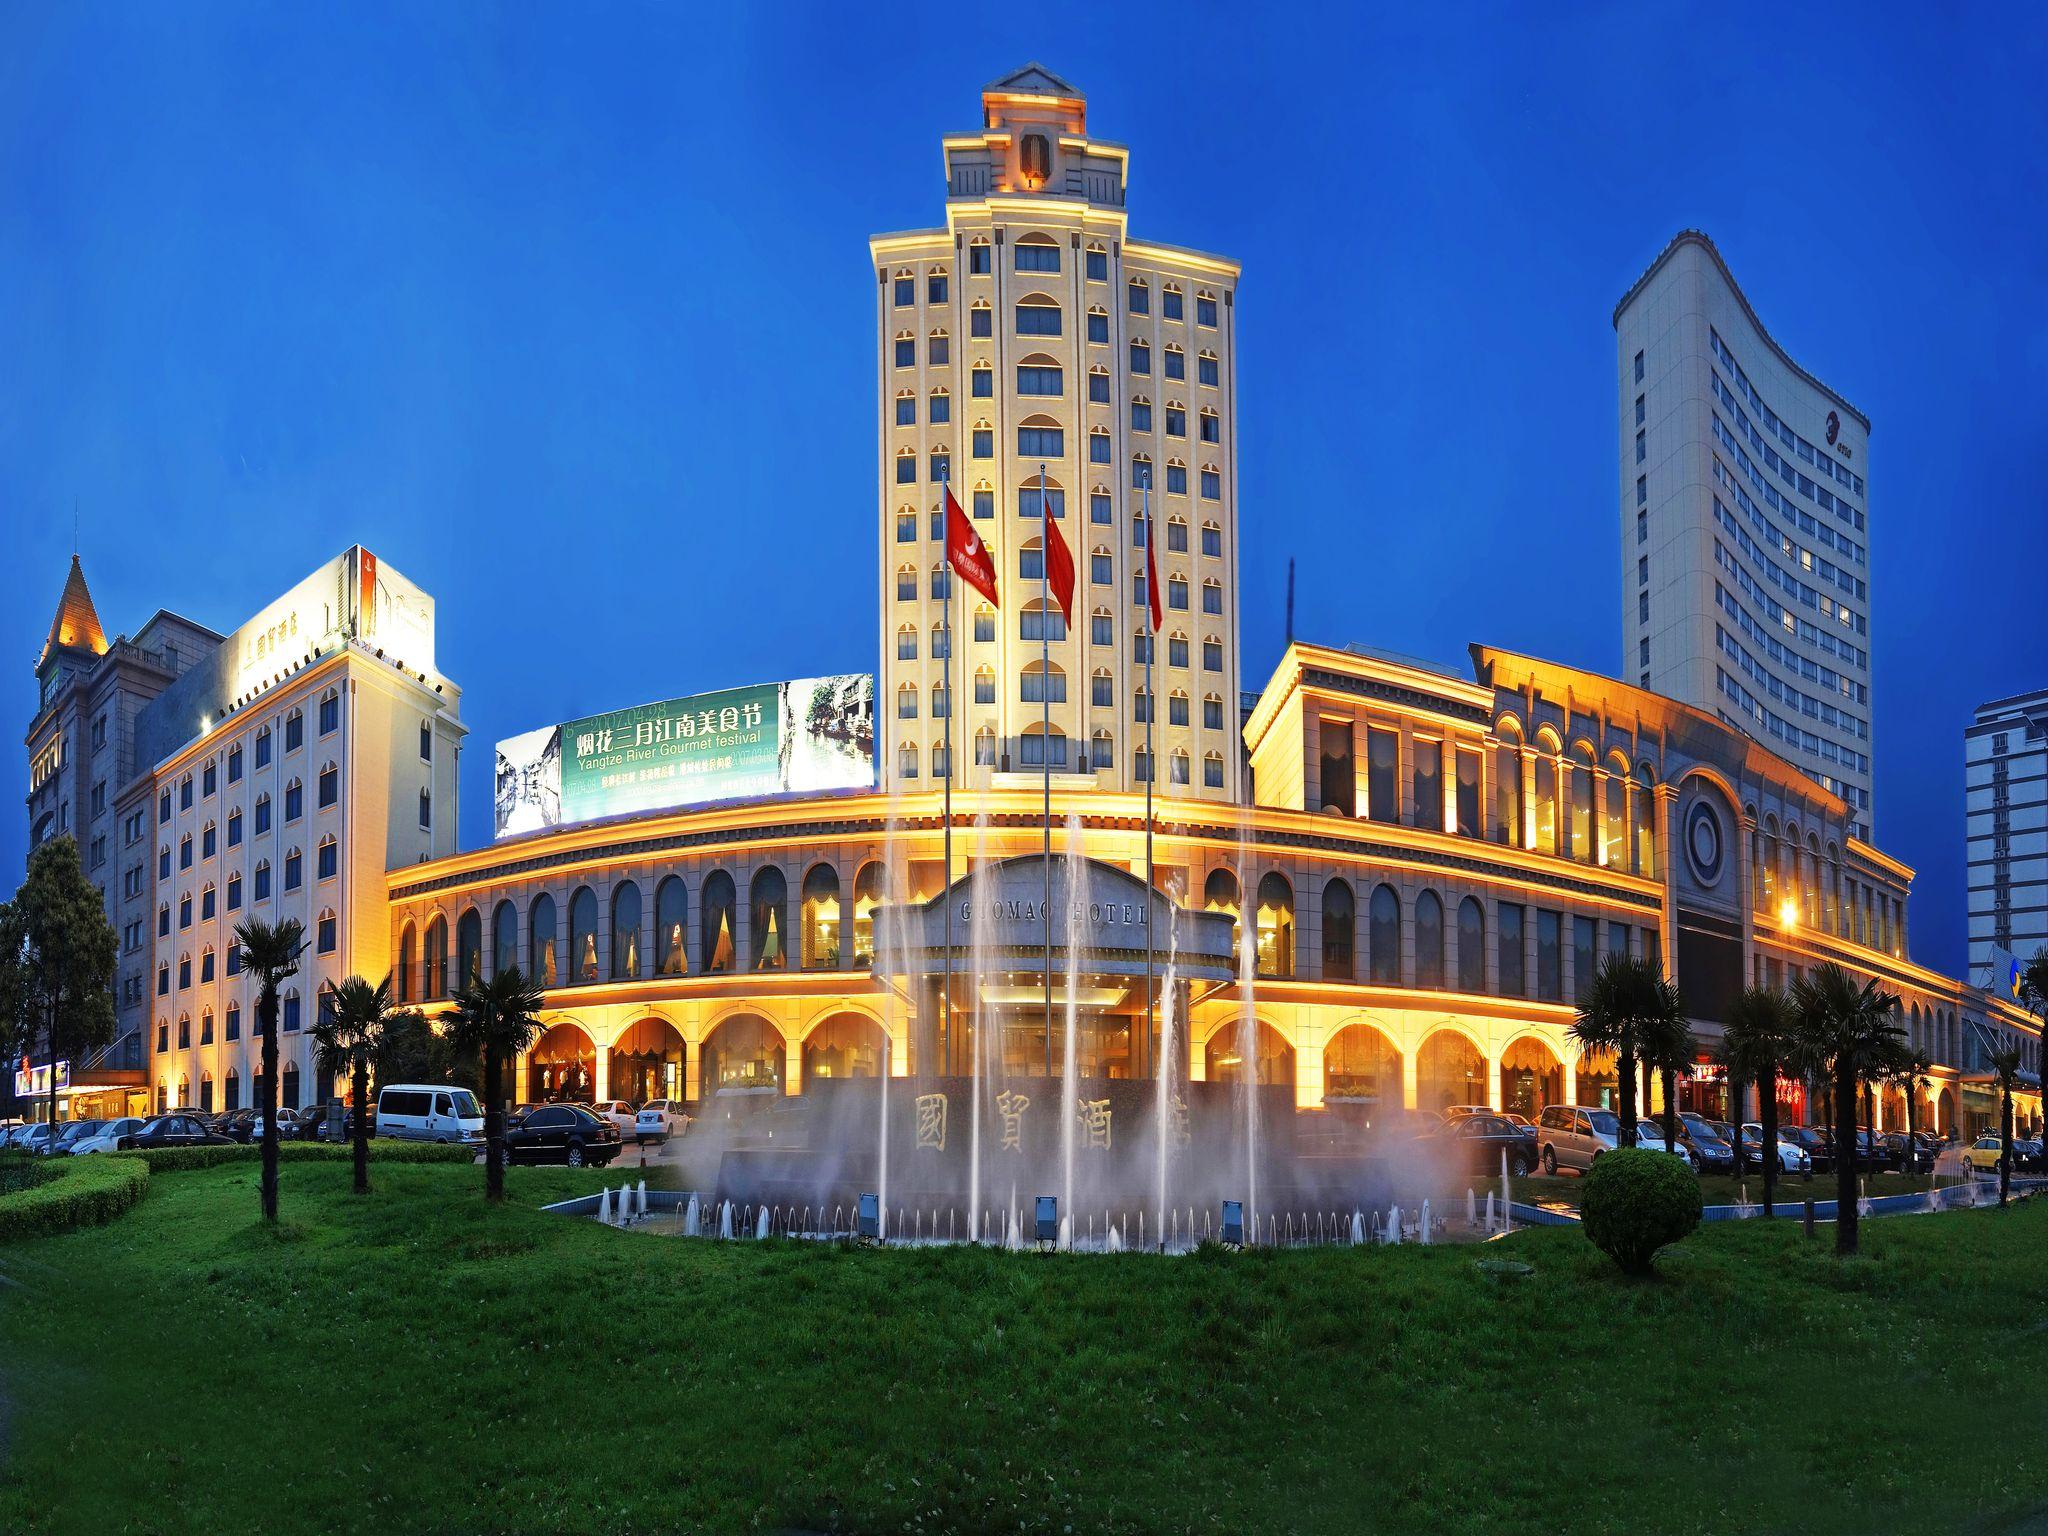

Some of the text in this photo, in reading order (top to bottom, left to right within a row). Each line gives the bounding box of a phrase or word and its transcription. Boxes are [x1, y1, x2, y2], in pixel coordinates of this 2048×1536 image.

[576, 702, 763, 758] 烟花三月江南美食节
[578, 754, 623, 771] Yangtze
[626, 748, 657, 762] River
[660, 736, 713, 756] Gourmet
[715, 729, 761, 748] festival
[960, 900, 1149, 925] GOMAO HOTEL
